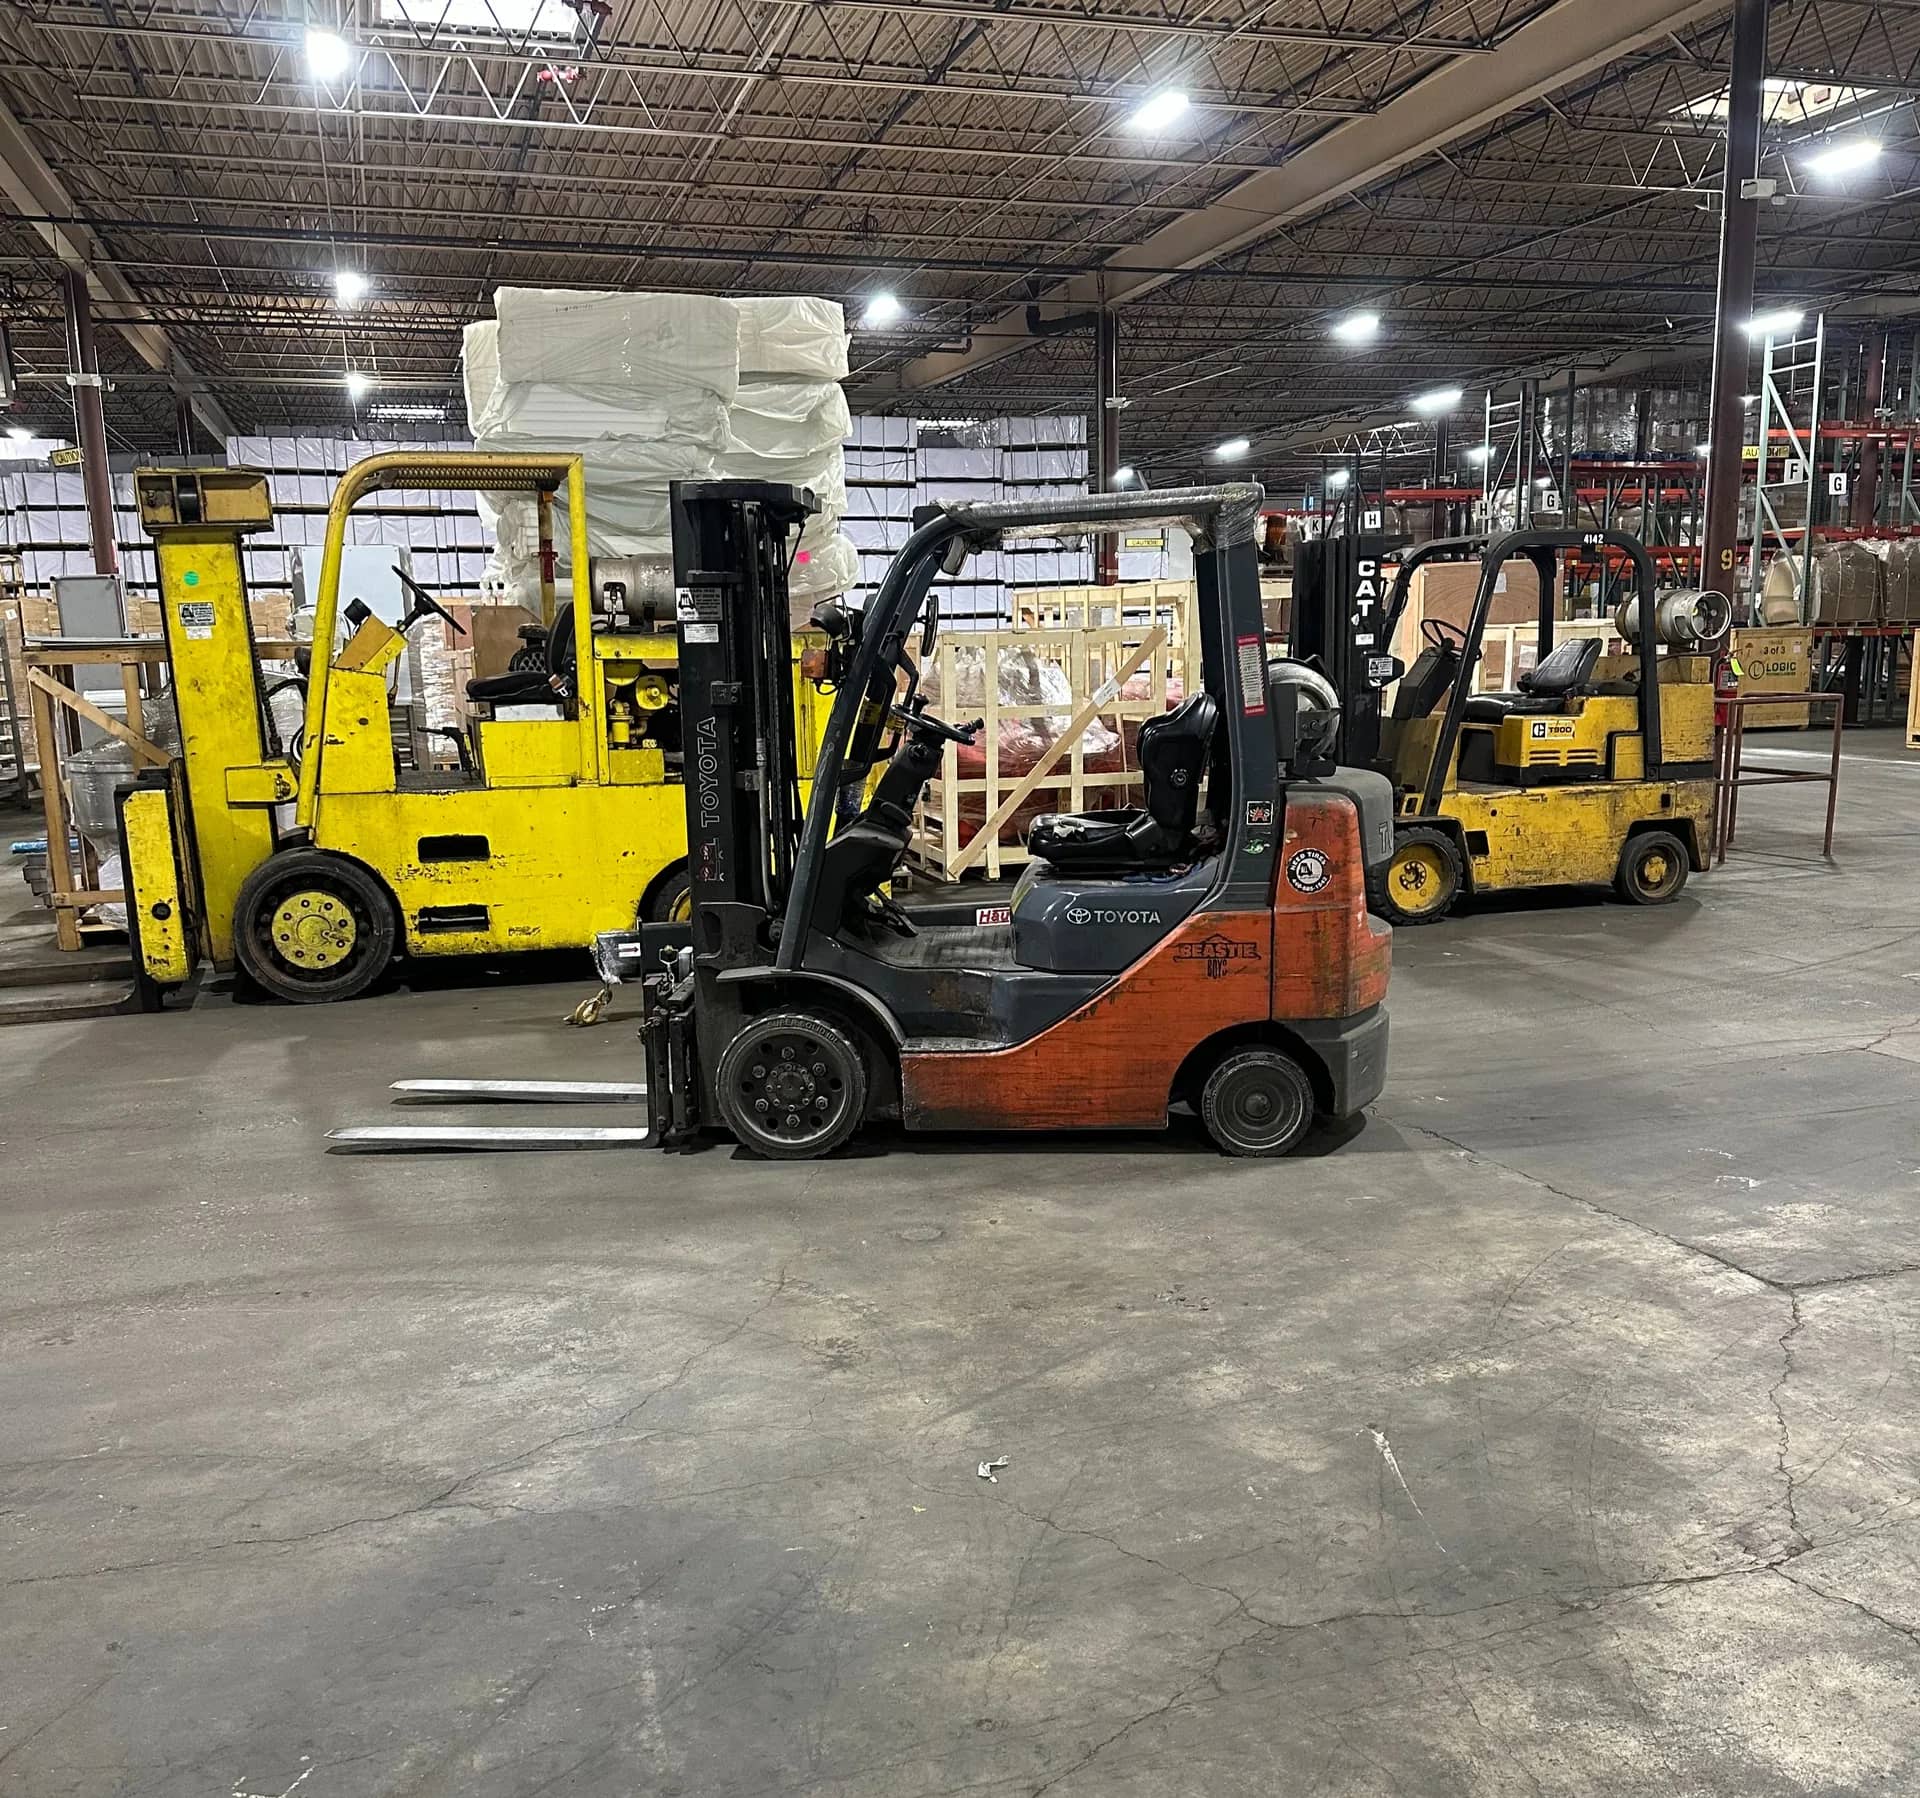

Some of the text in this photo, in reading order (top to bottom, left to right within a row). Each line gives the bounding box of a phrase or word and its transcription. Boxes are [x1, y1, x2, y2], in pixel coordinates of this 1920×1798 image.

[1788, 463, 1799, 480] F
[1833, 476, 1843, 492] G
[1546, 494, 1555, 508] G
[1479, 501, 1489, 517] H
[1311, 519, 1320, 532] K
[1368, 513, 1377, 526] H
[1583, 533, 1604, 544] 4142
[1720, 549, 1733, 571] 9
[1355, 560, 1377, 617] CAT
[1770, 645, 1779, 655] of
[1780, 645, 1786, 655] 3
[1766, 661, 1797, 672] LOGIC
[696, 716, 720, 828] TOYOTA
[1290, 853, 1306, 871] NEED
[1094, 910, 1161, 924] TOYOTA
[1181, 943, 1256, 958] BEASTIE
